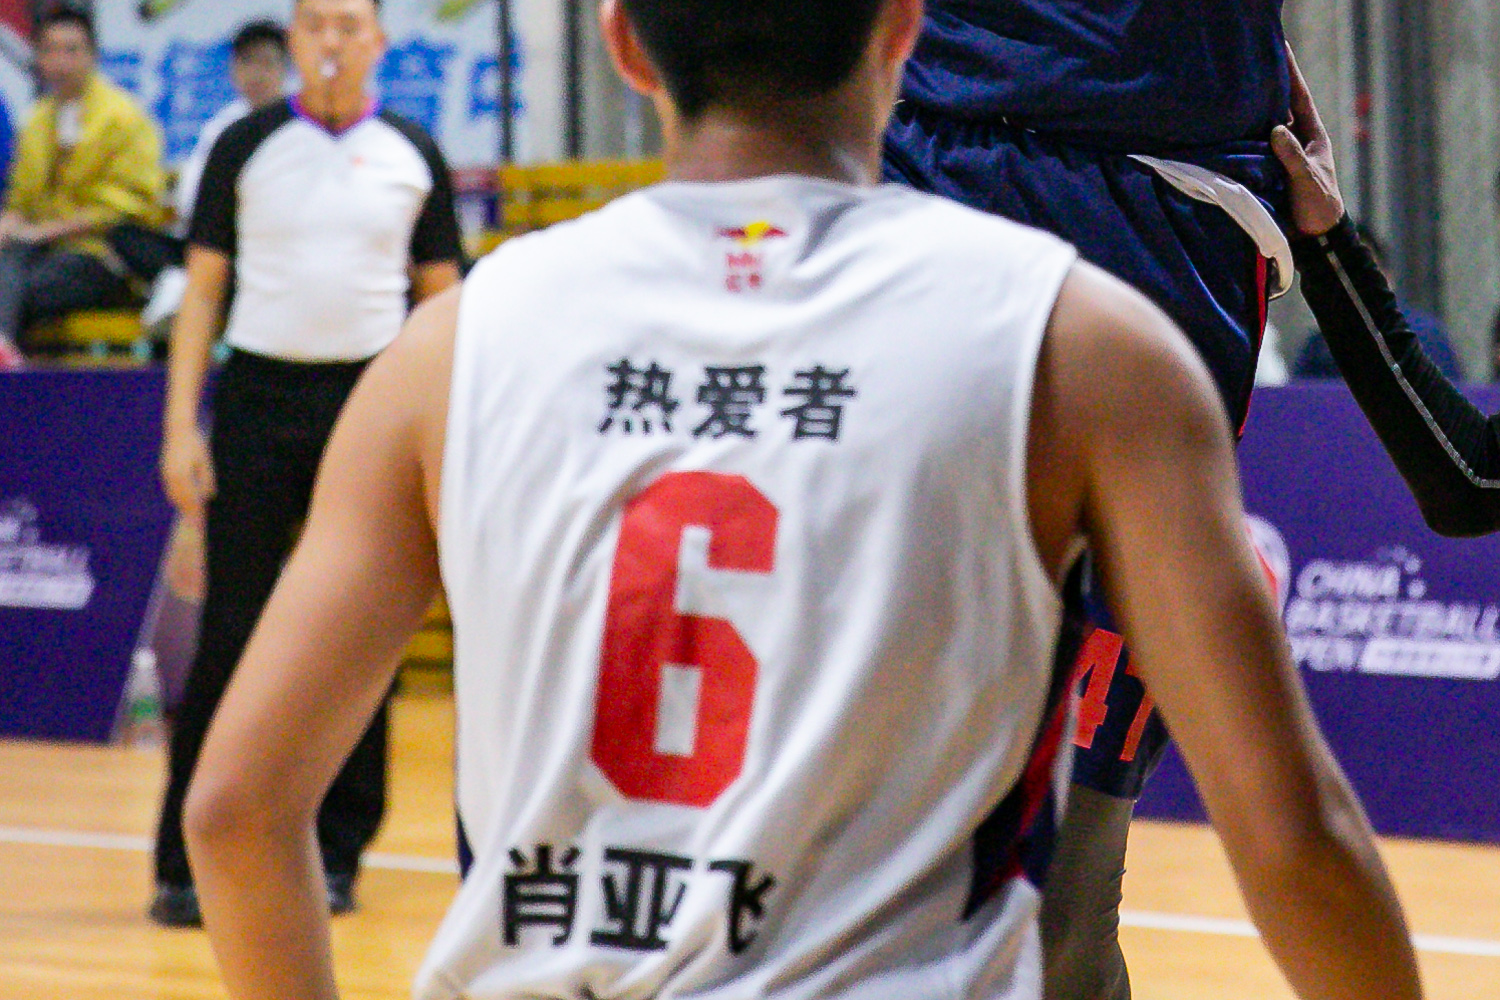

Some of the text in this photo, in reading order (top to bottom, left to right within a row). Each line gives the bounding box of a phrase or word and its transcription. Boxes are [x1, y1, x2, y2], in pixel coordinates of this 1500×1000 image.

[597, 358, 859, 442] 热爱者
[588, 470, 780, 808] 6
[499, 843, 778, 955] 肖亚飞
